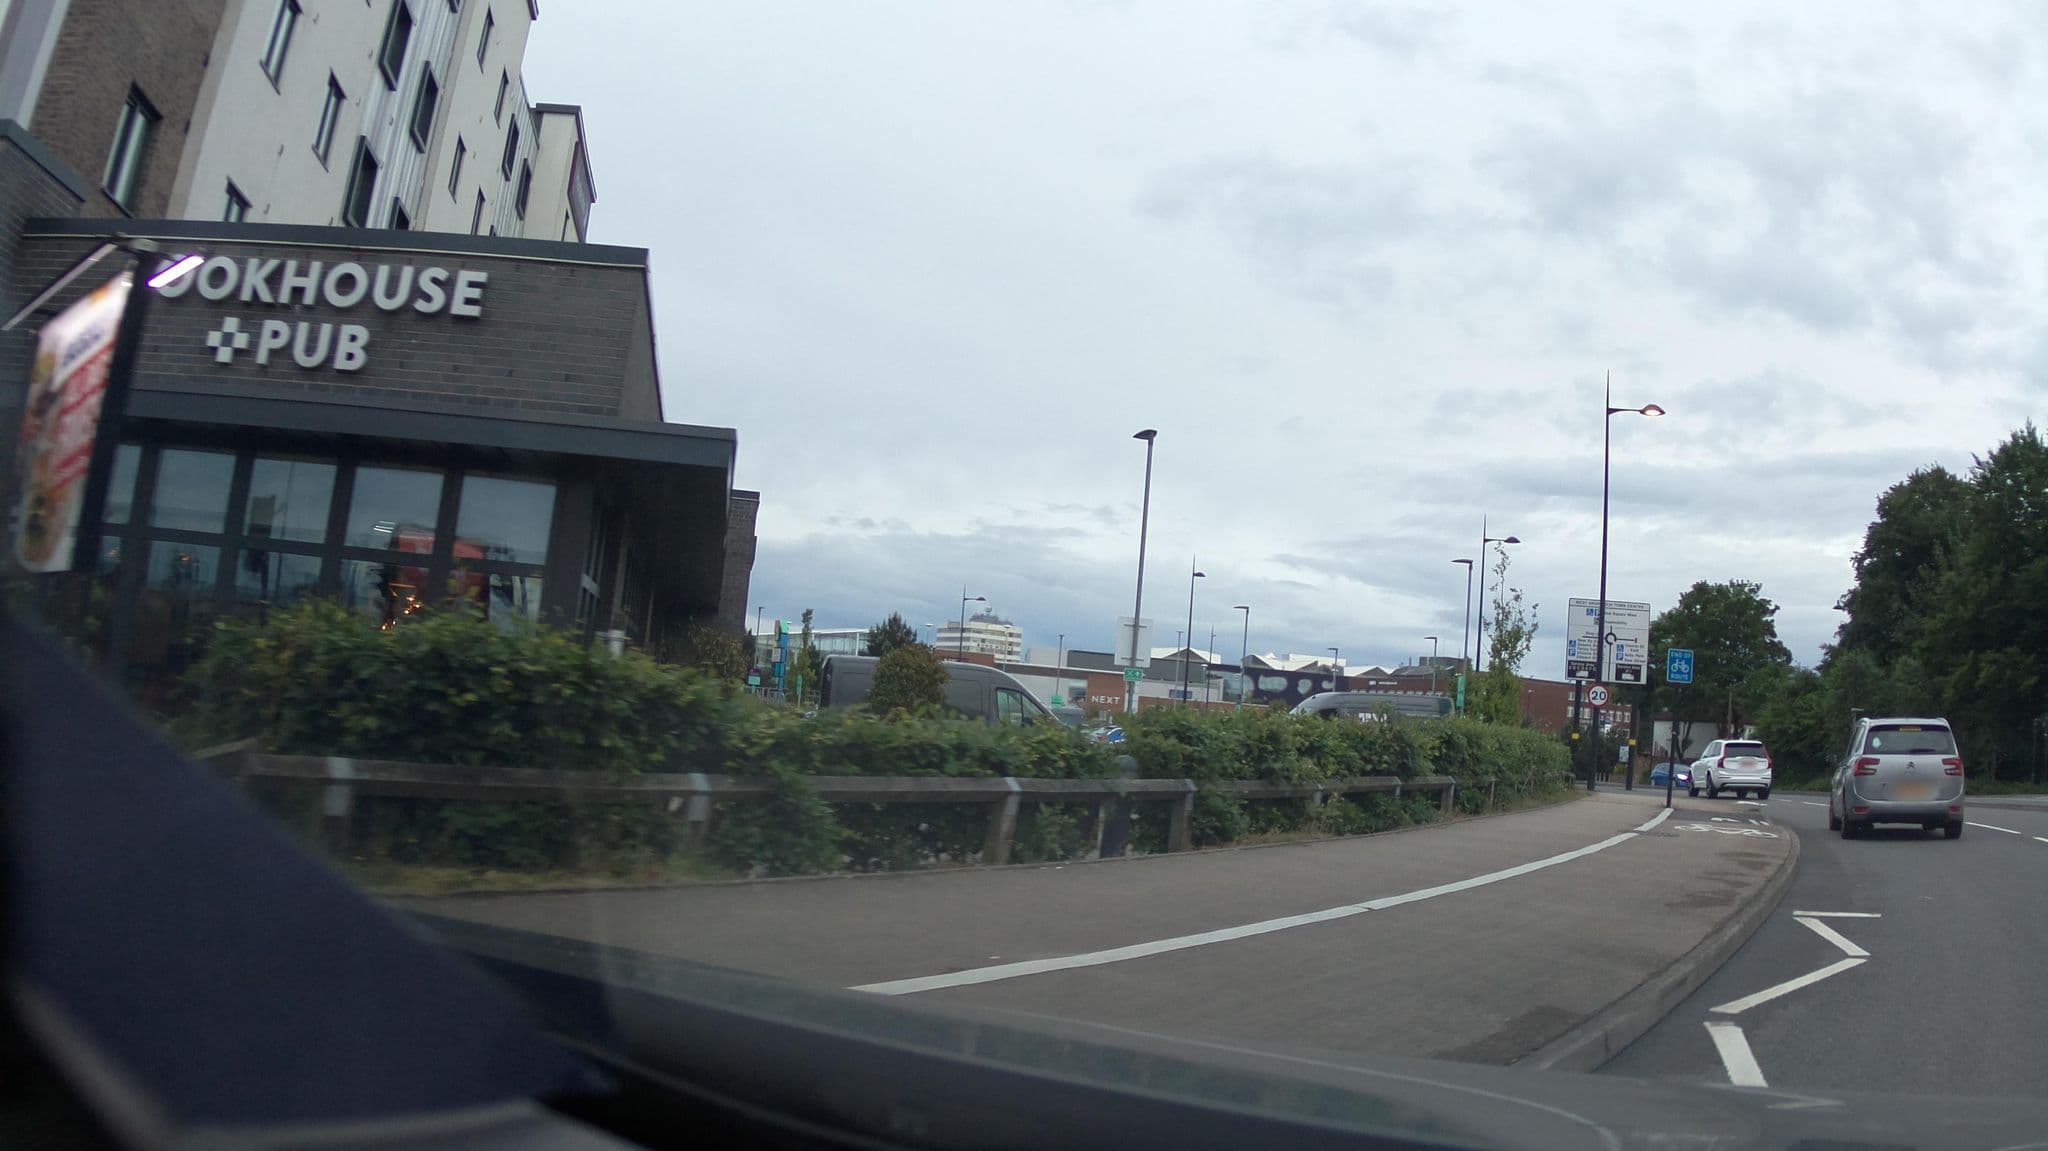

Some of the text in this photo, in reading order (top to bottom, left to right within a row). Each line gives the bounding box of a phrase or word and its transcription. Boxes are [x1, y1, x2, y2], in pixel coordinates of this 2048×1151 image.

[255, 319, 371, 371] PUB
[1091, 695, 1120, 704] NEXT
[1591, 691, 1606, 701] 20
